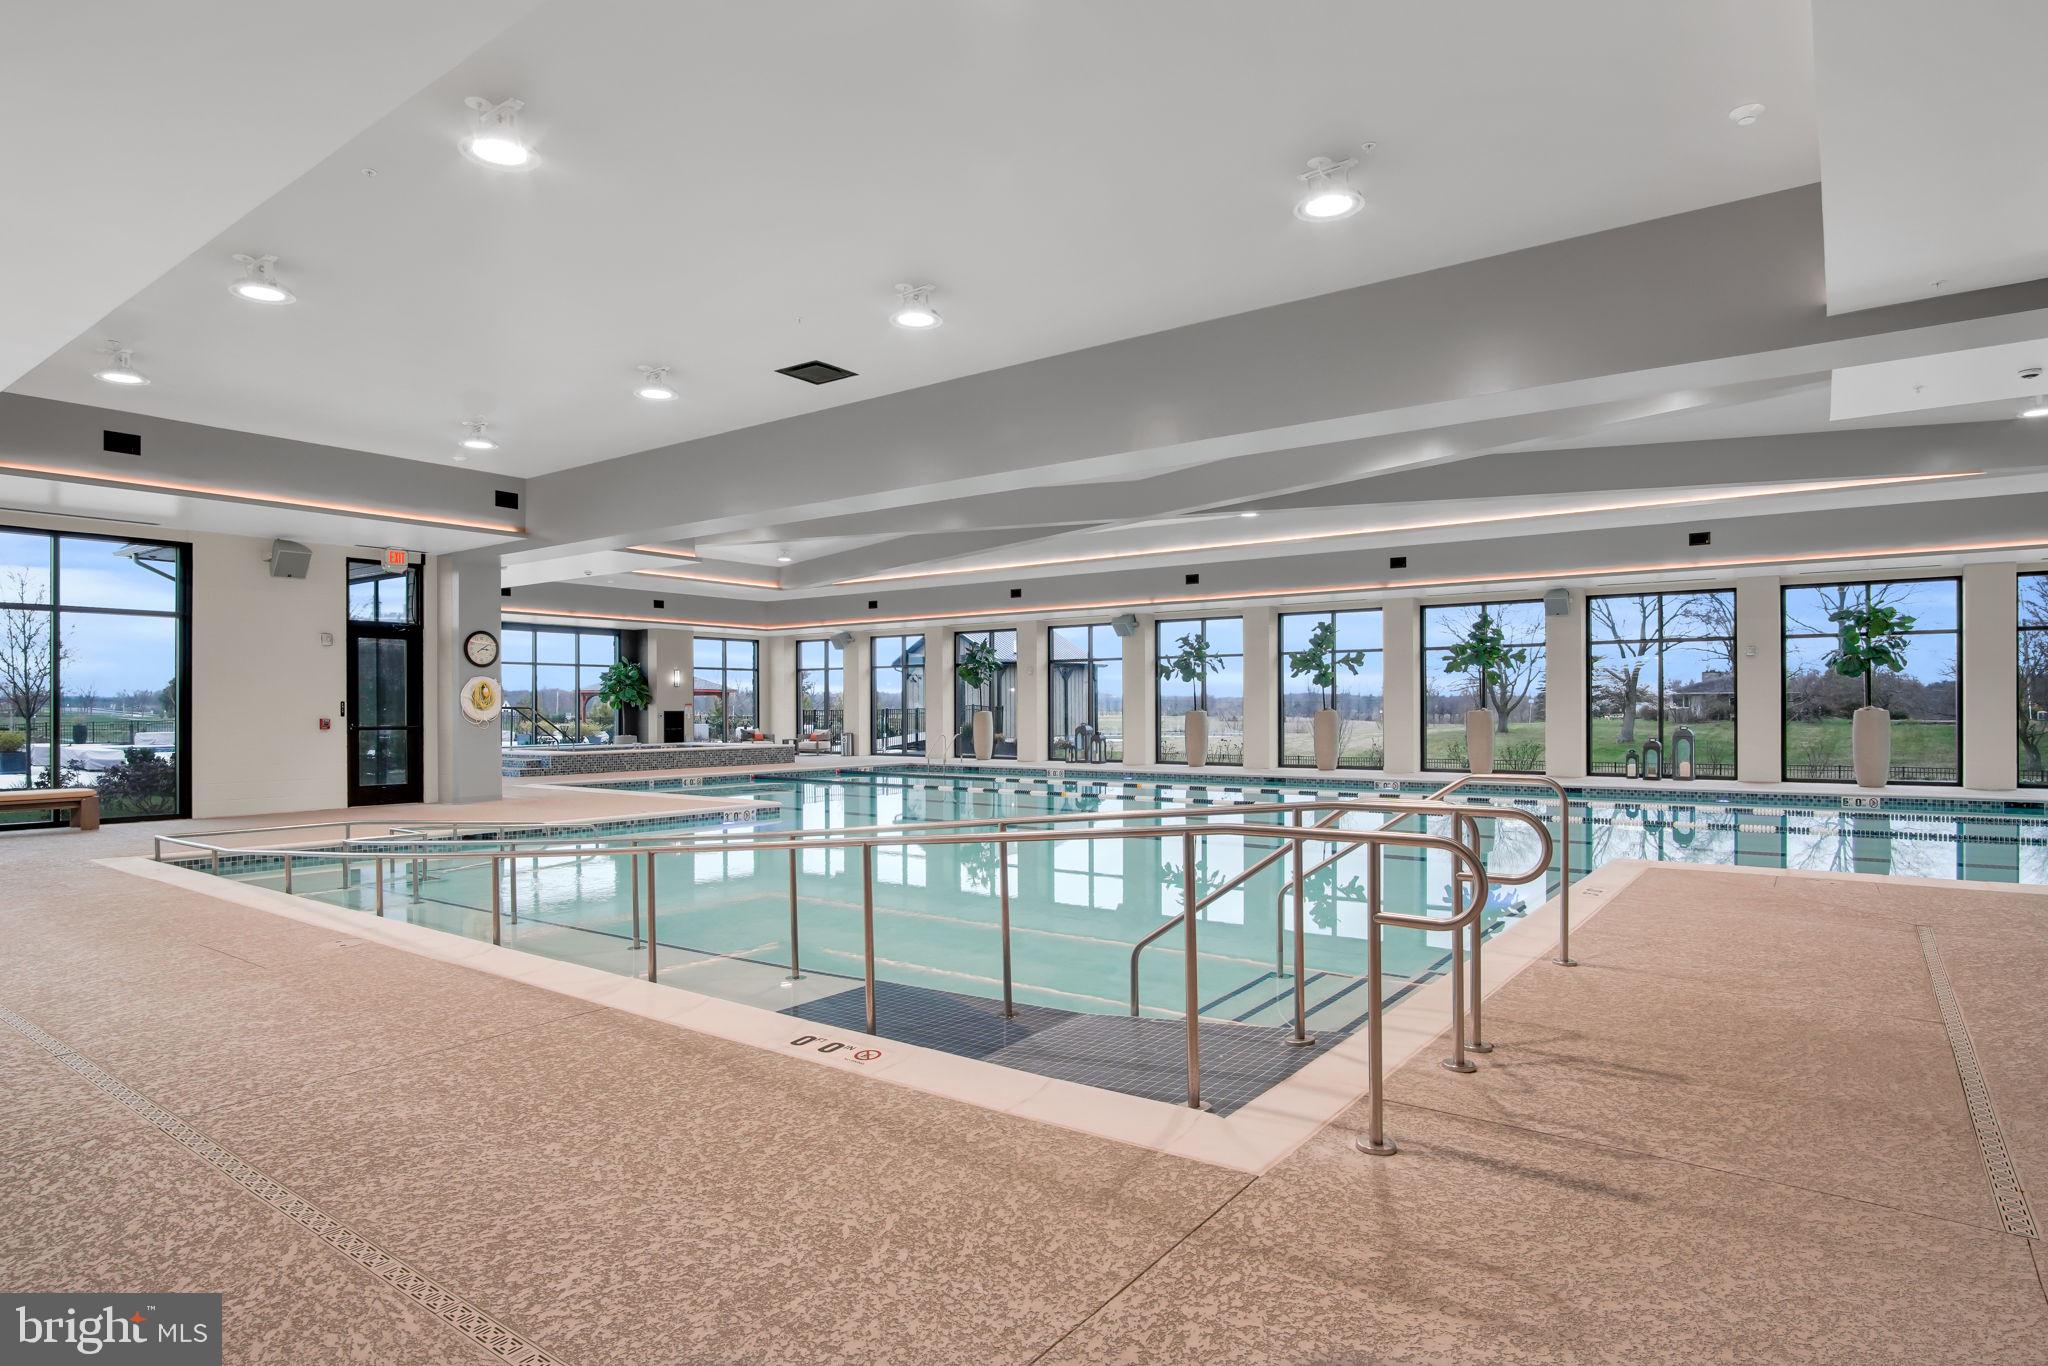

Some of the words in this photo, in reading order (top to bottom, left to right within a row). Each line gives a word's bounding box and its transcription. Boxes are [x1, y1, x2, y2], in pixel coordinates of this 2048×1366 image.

[389, 550, 405, 565] EXIT
[1855, 798, 1862, 807] 0
[790, 1035, 817, 1046] 0
[817, 1042, 846, 1053] 0
